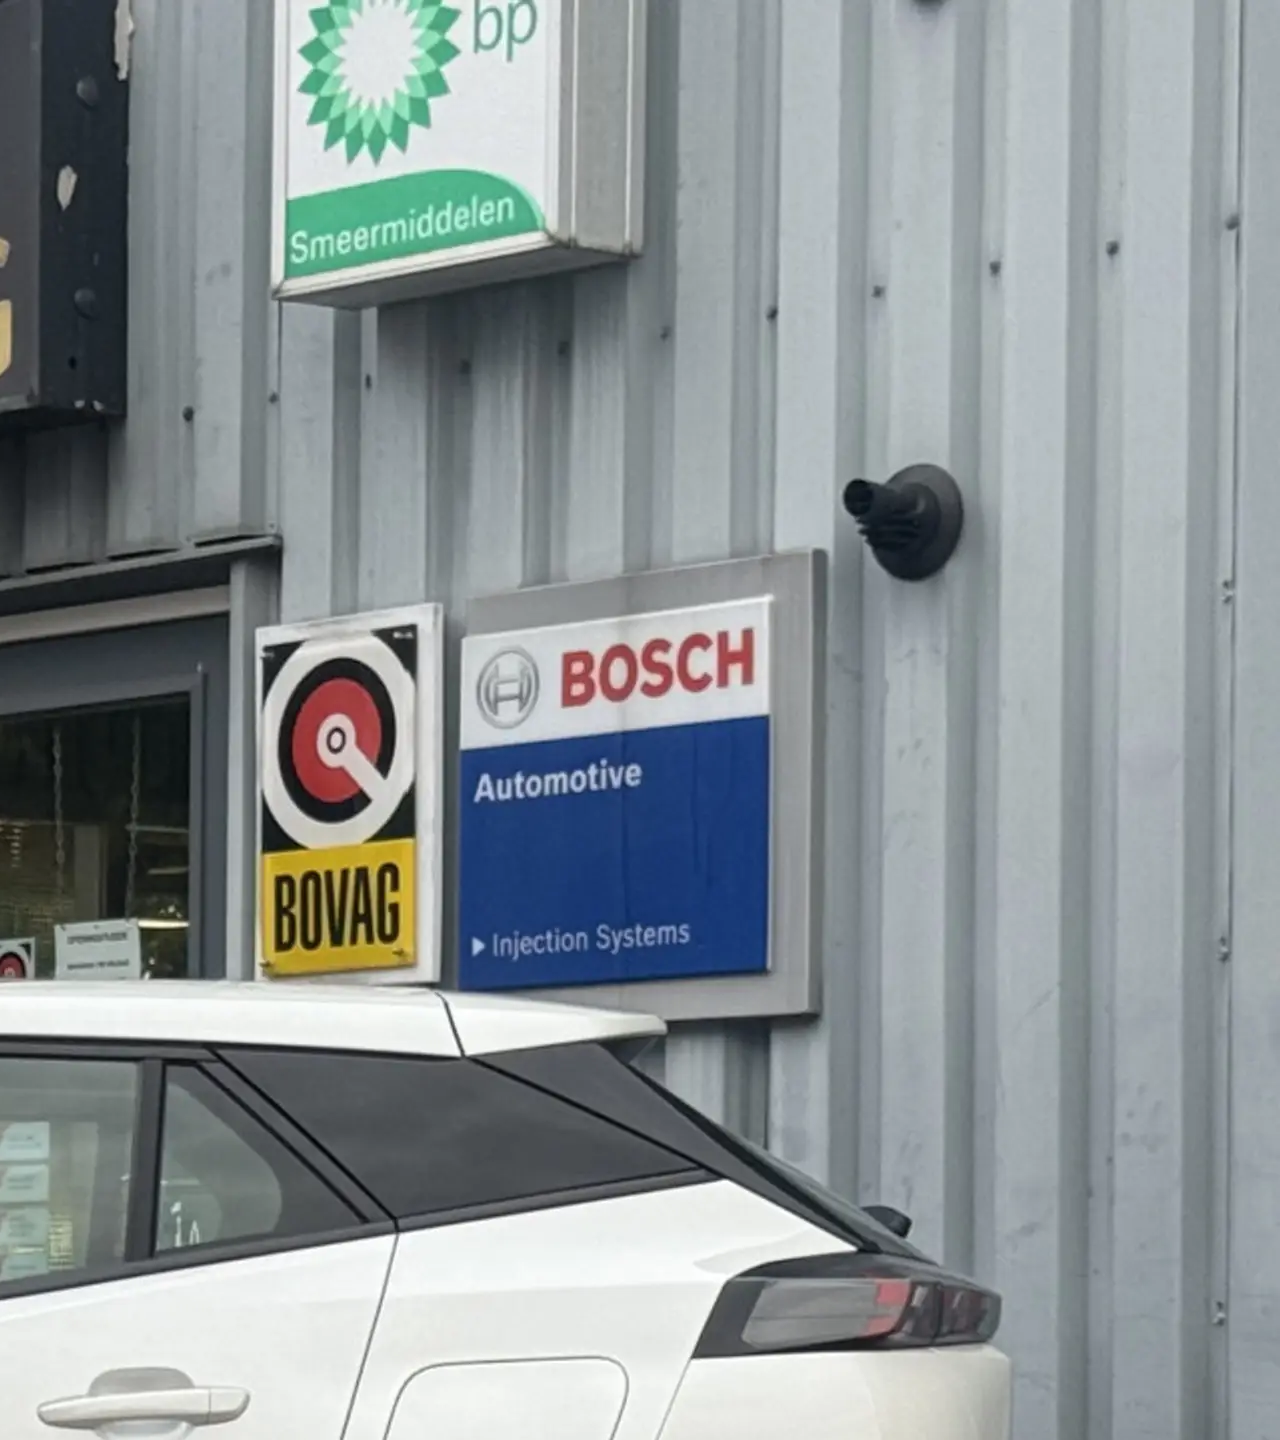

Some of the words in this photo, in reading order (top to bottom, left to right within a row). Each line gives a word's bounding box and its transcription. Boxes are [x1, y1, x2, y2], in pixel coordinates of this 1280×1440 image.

[473, 0, 538, 63] bp
[290, 194, 516, 265] Smeermiddelen
[560, 627, 755, 709] BOSCH
[473, 758, 643, 803] Automotive
[273, 862, 401, 953] BOVAG
[492, 929, 589, 961] Injection
[595, 922, 691, 957] Systems
